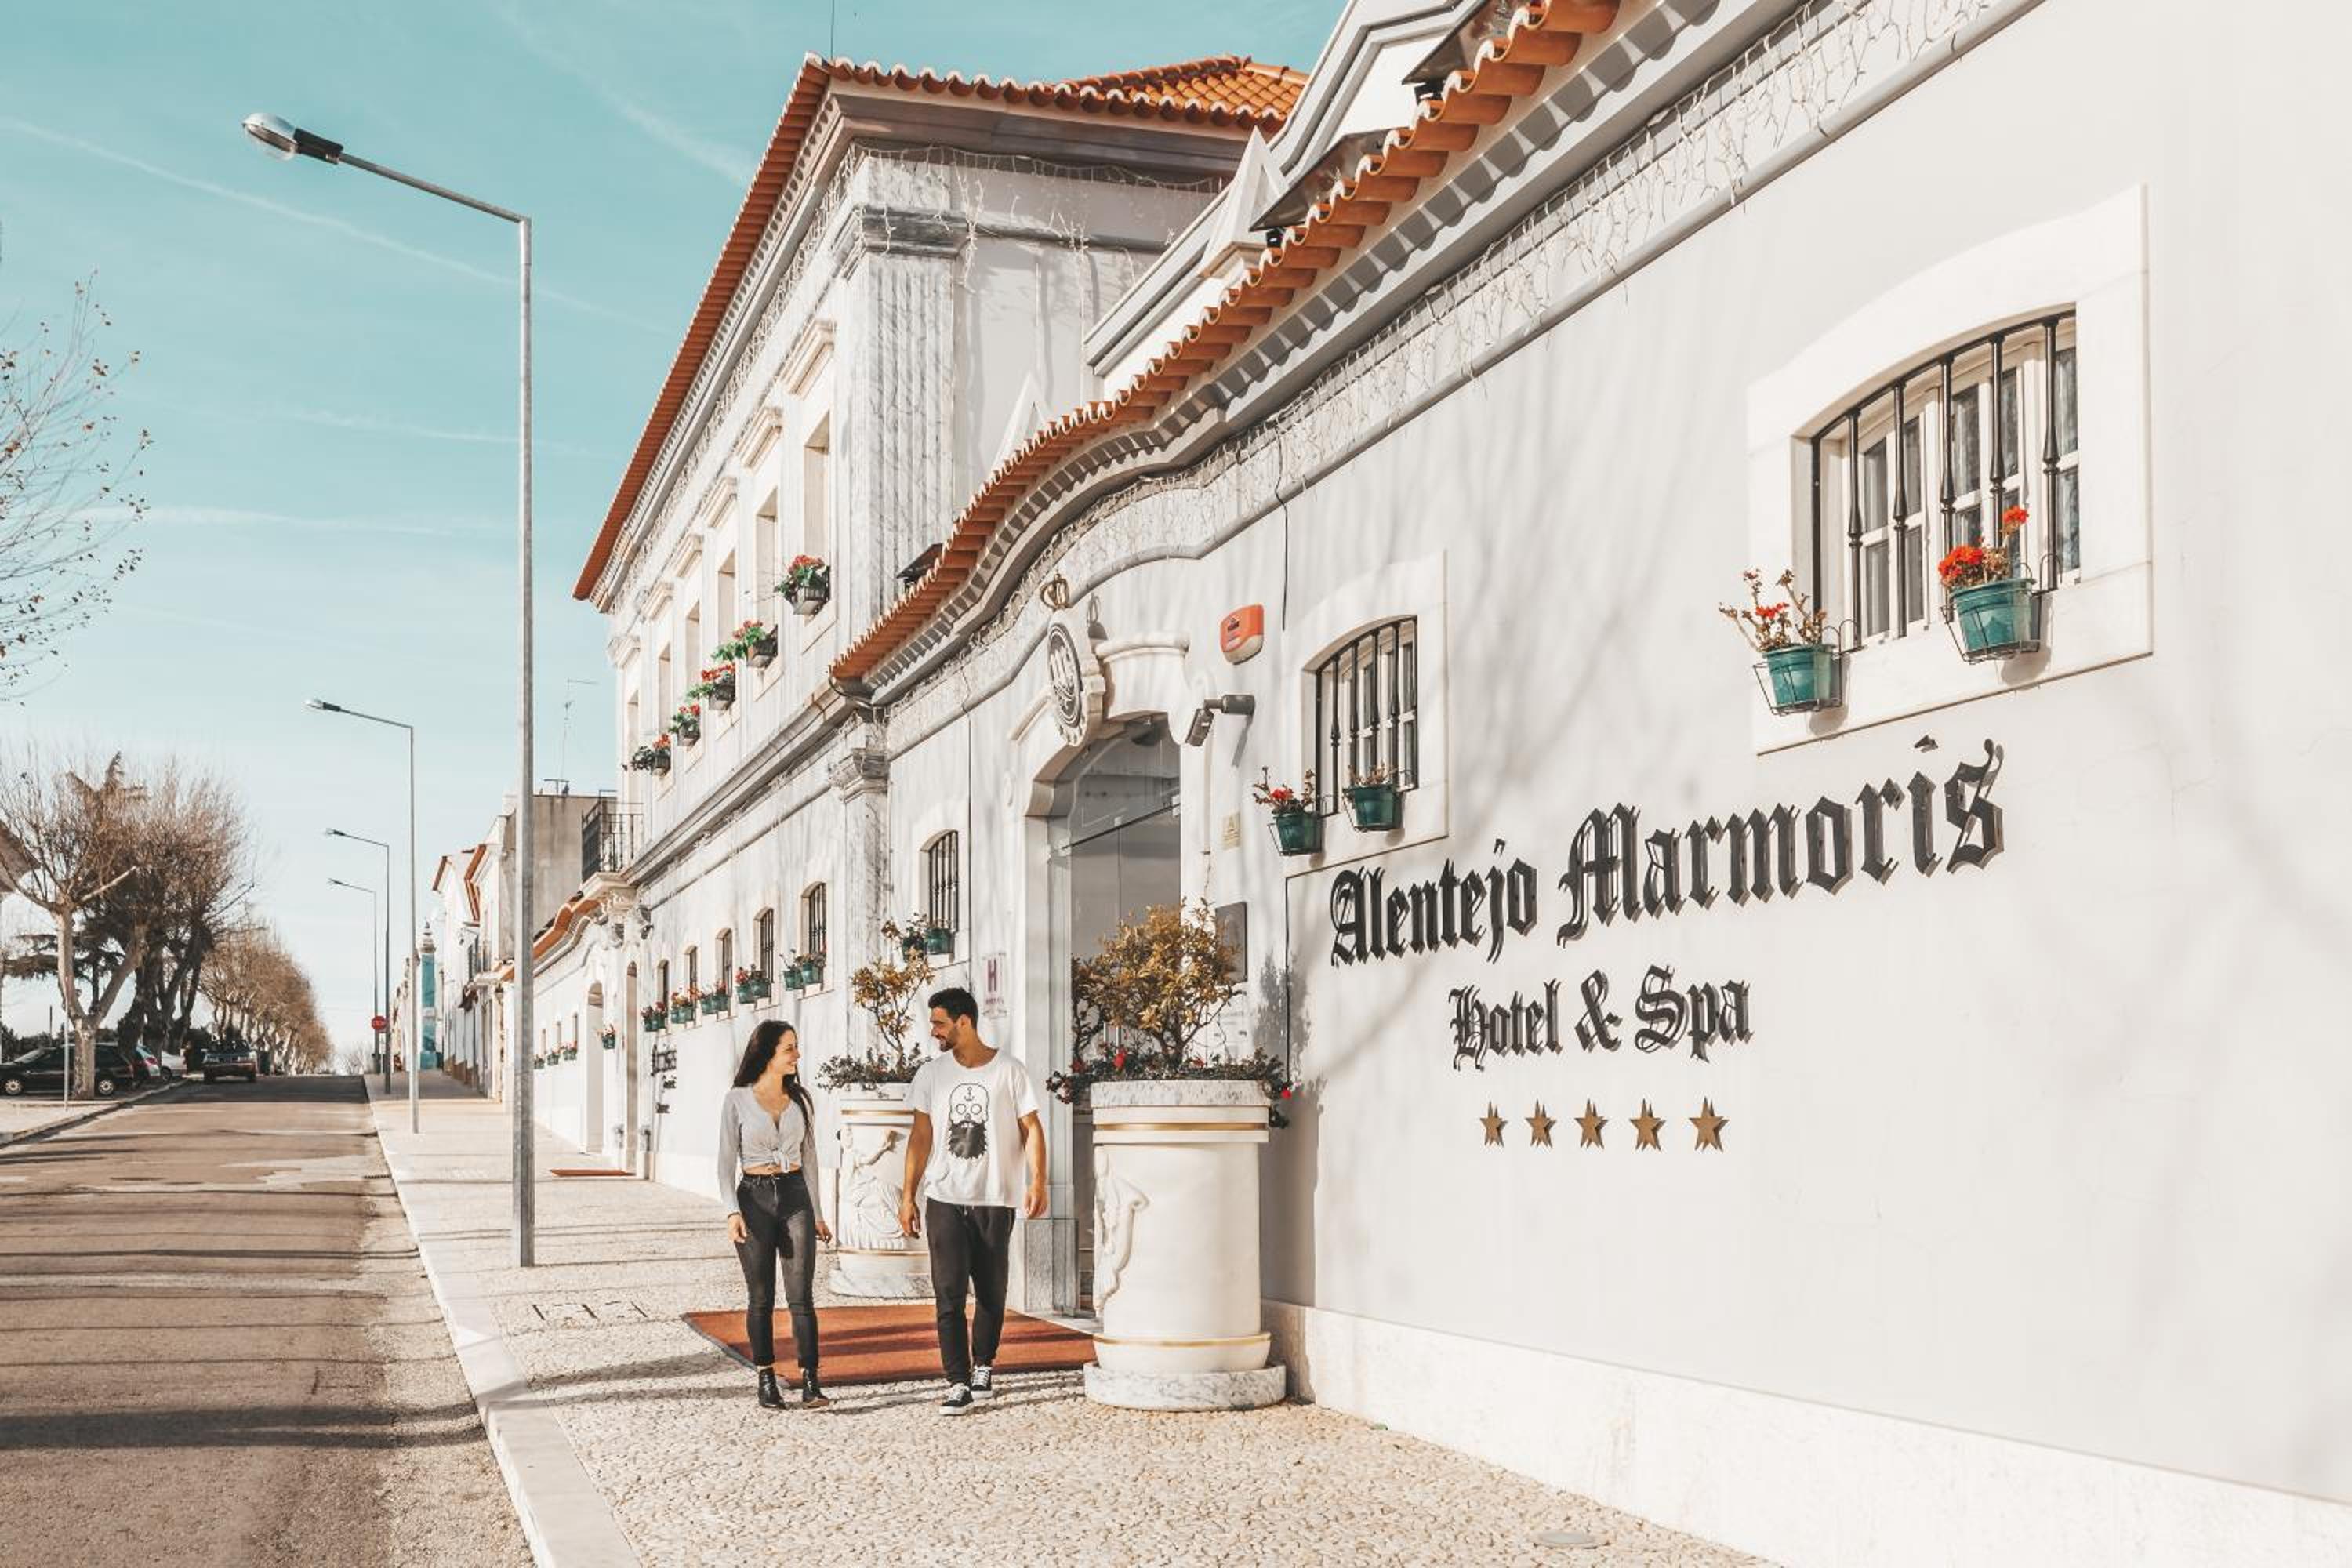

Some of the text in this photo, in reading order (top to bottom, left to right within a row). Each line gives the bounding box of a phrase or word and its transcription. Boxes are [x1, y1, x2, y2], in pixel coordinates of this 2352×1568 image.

[1330, 735, 2003, 967] Alentejo Marmoris
[1449, 965, 1751, 1070] Hotel & Spa
